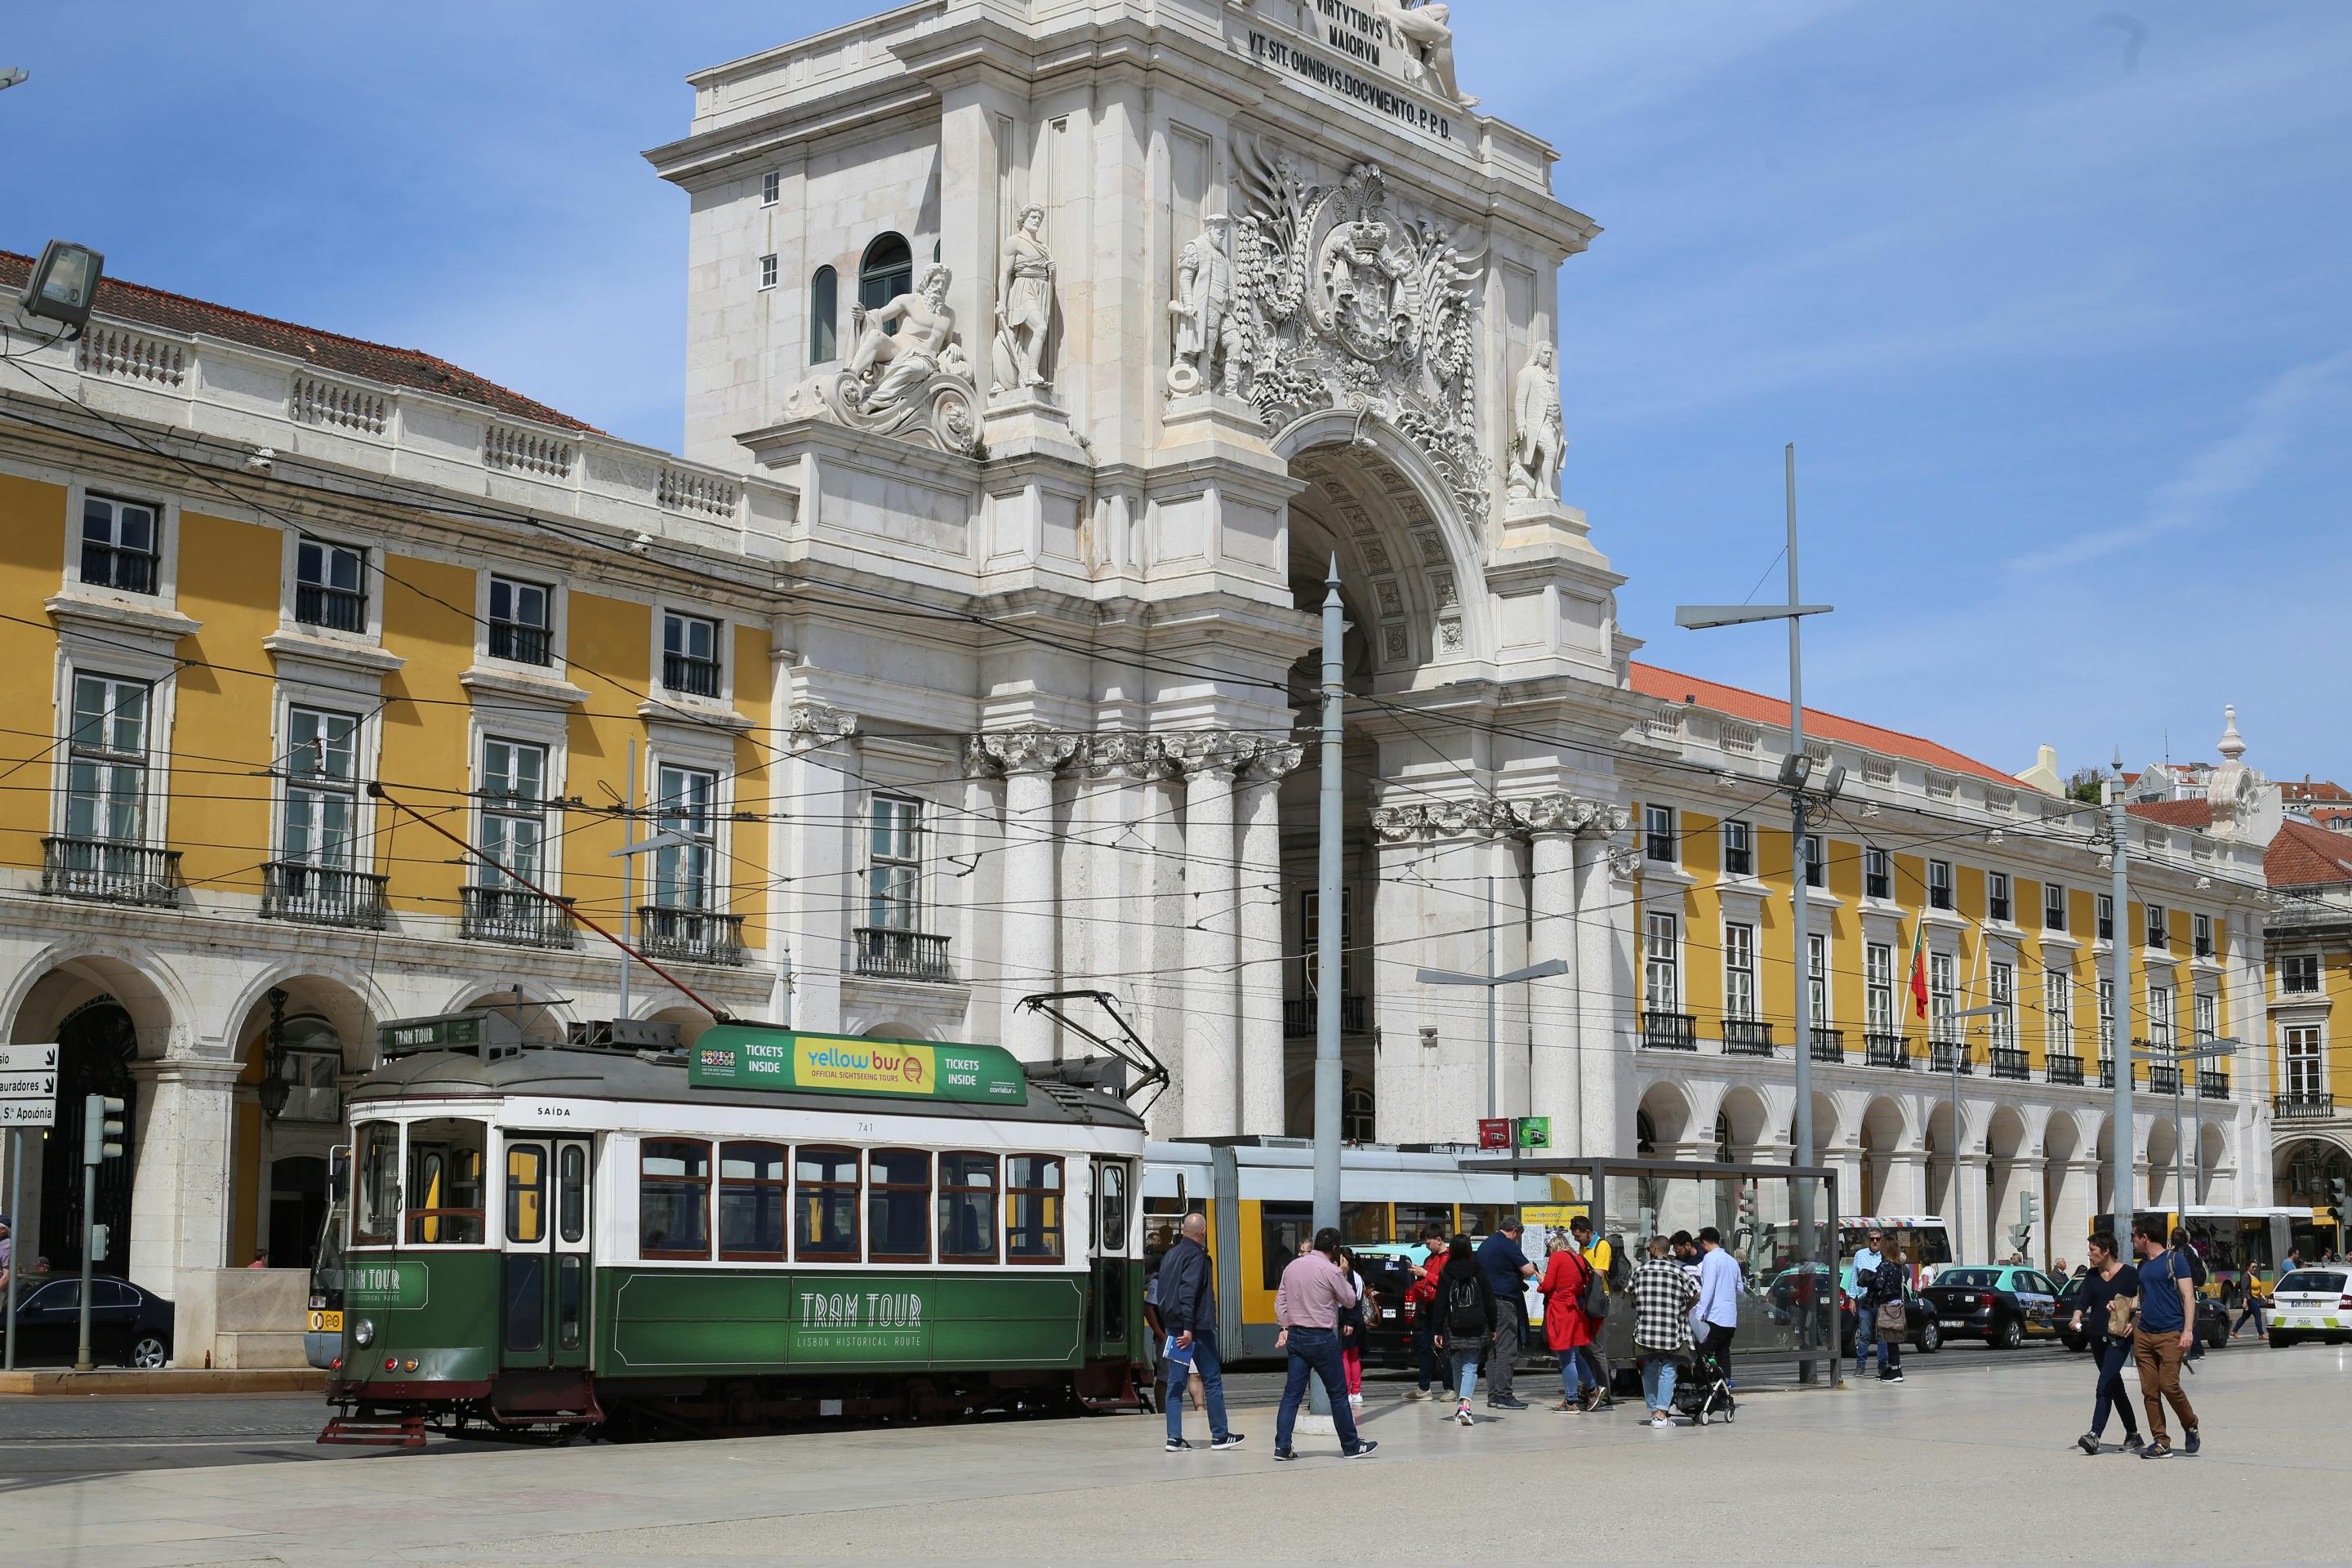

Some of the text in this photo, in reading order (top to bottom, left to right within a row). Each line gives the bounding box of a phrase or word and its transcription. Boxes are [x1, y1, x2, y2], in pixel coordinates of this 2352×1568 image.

[1316, 0, 1382, 40] VIRTVTIBVS
[1249, 30, 1265, 57] VT.
[1269, 40, 1288, 67] SIT.
[1329, 24, 1380, 66] MAIORVM
[395, 1028, 433, 1046] TRAM TOUR
[745, 1045, 783, 1058] TICKETS
[748, 1060, 780, 1073] INSIDE
[872, 1051, 900, 1071] bus
[945, 1058, 979, 1070] TICKETS
[811, 1070, 837, 1078] OFFICIAL
[839, 1071, 877, 1081] SIGHTSEEING
[948, 1074, 976, 1086] INSIDE
[0, 1080, 39, 1091] auradores
[16, 1107, 52, 1121] Apolónia
[537, 1106, 570, 1116] SAÍDA
[858, 1123, 873, 1132] 741
[368, 1269, 400, 1290] TOUR
[801, 1293, 921, 1327] TRAM TOUR
[797, 1336, 921, 1347] LISBON HISTORICAL ROUTE
